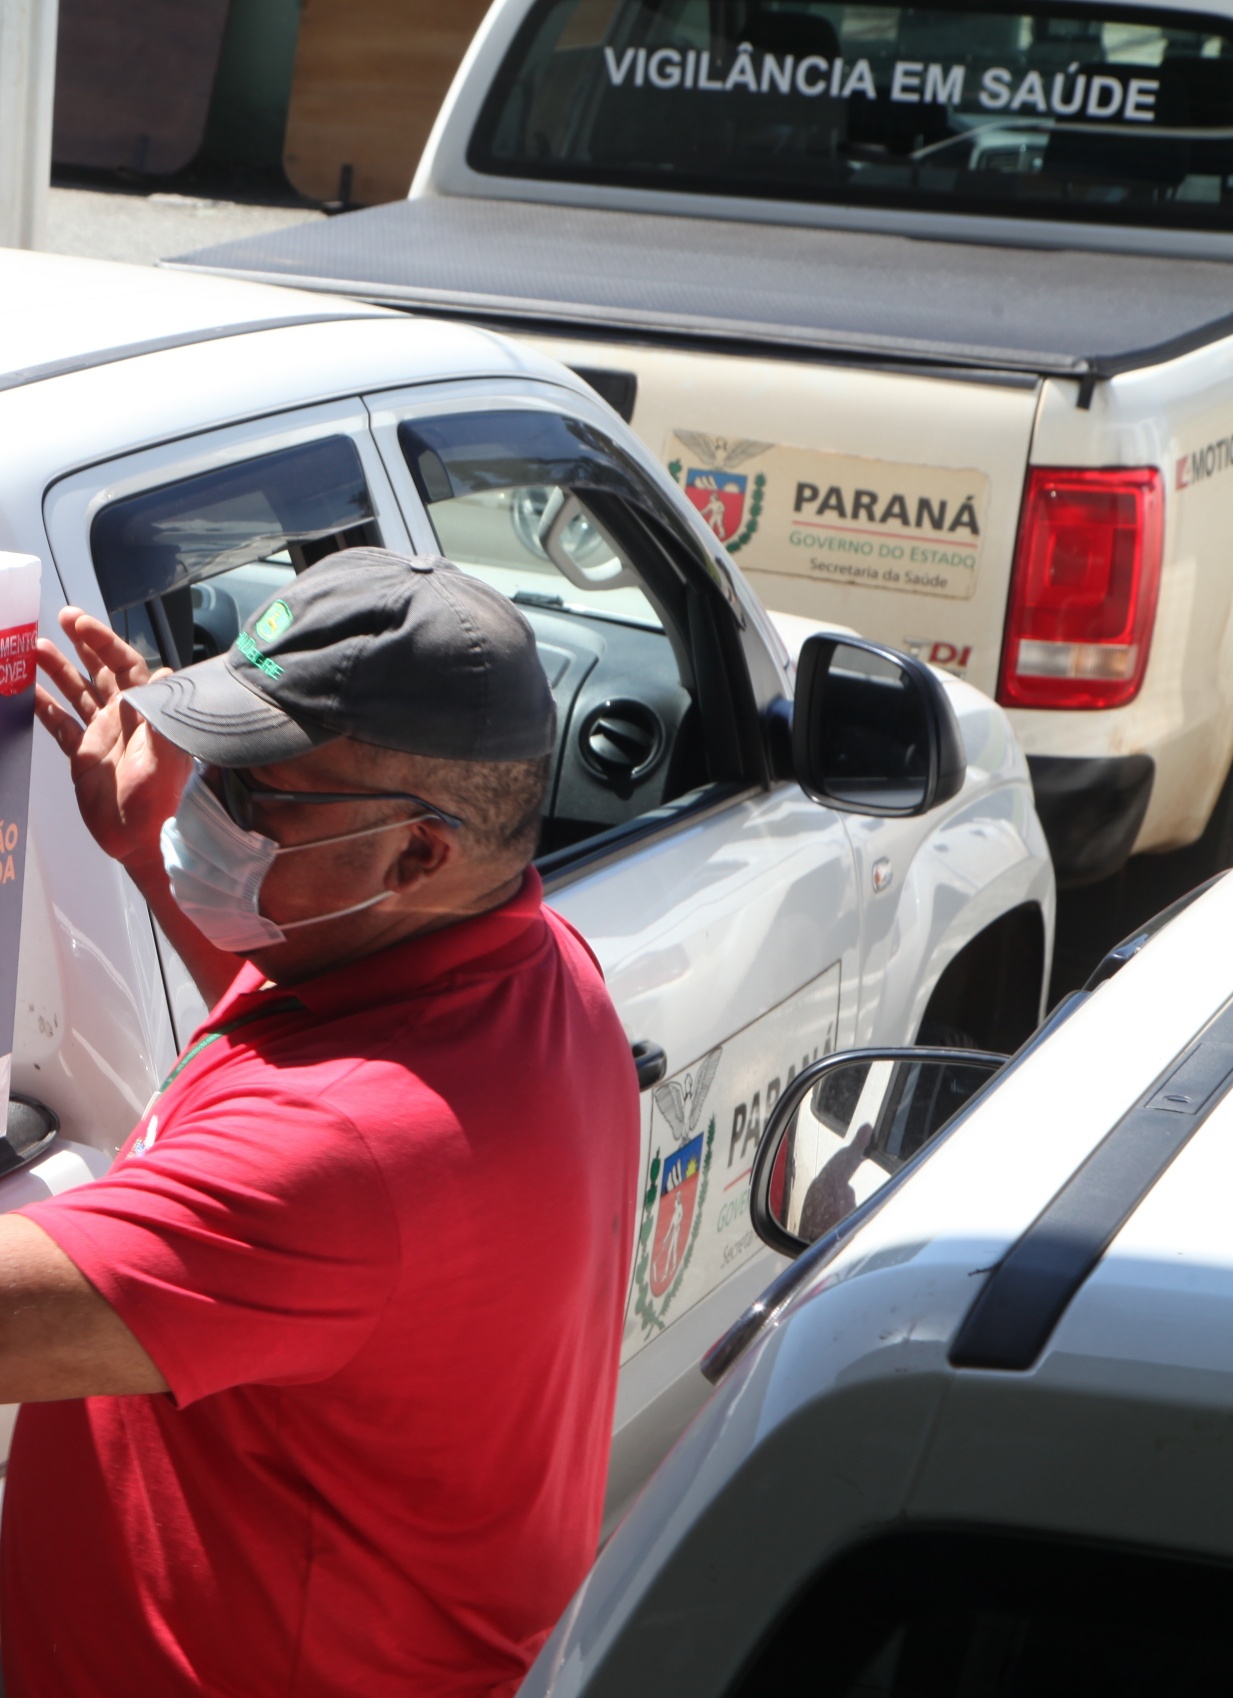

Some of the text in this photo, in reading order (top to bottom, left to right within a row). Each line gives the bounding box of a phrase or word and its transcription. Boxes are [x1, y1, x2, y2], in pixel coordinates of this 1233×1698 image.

[604, 42, 1160, 121] VIGILÂNCIA EM SAÚDE
[793, 481, 980, 536] PARANÁ
[789, 529, 977, 569] GOVERNO DO ESTADO
[810, 557, 949, 589] Secretaria da Saúde
